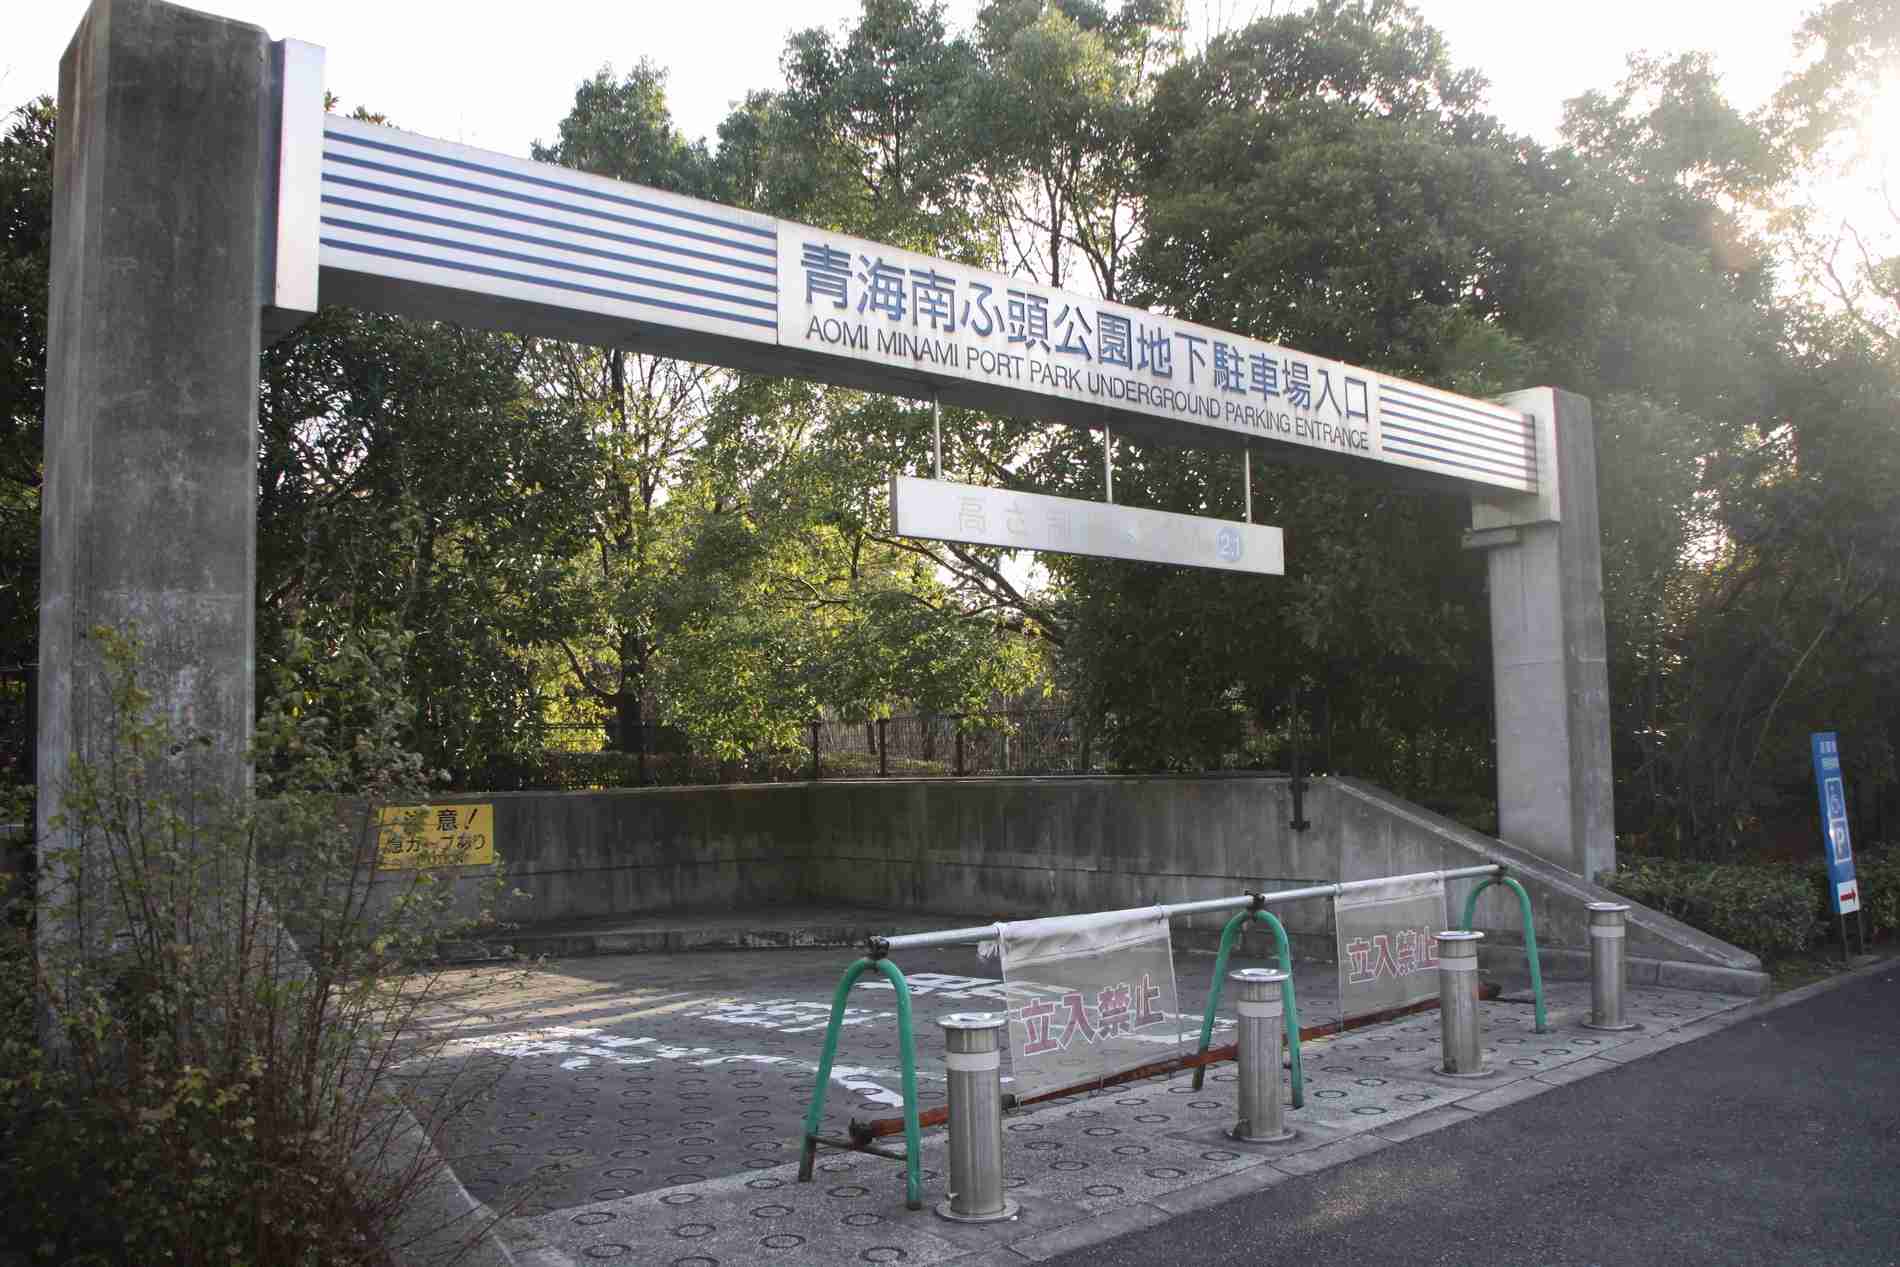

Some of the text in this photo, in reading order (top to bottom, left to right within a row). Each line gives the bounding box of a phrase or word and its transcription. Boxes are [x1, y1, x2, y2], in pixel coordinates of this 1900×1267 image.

[801, 242, 1369, 423] 青海南ふ頭公園地下駐車場入口
[805, 315, 1369, 450] AOMI MINAMI PORT PARK UNDERGROUND PARKING ENTRANCE
[1020, 973, 1166, 1056] 立入禁止
